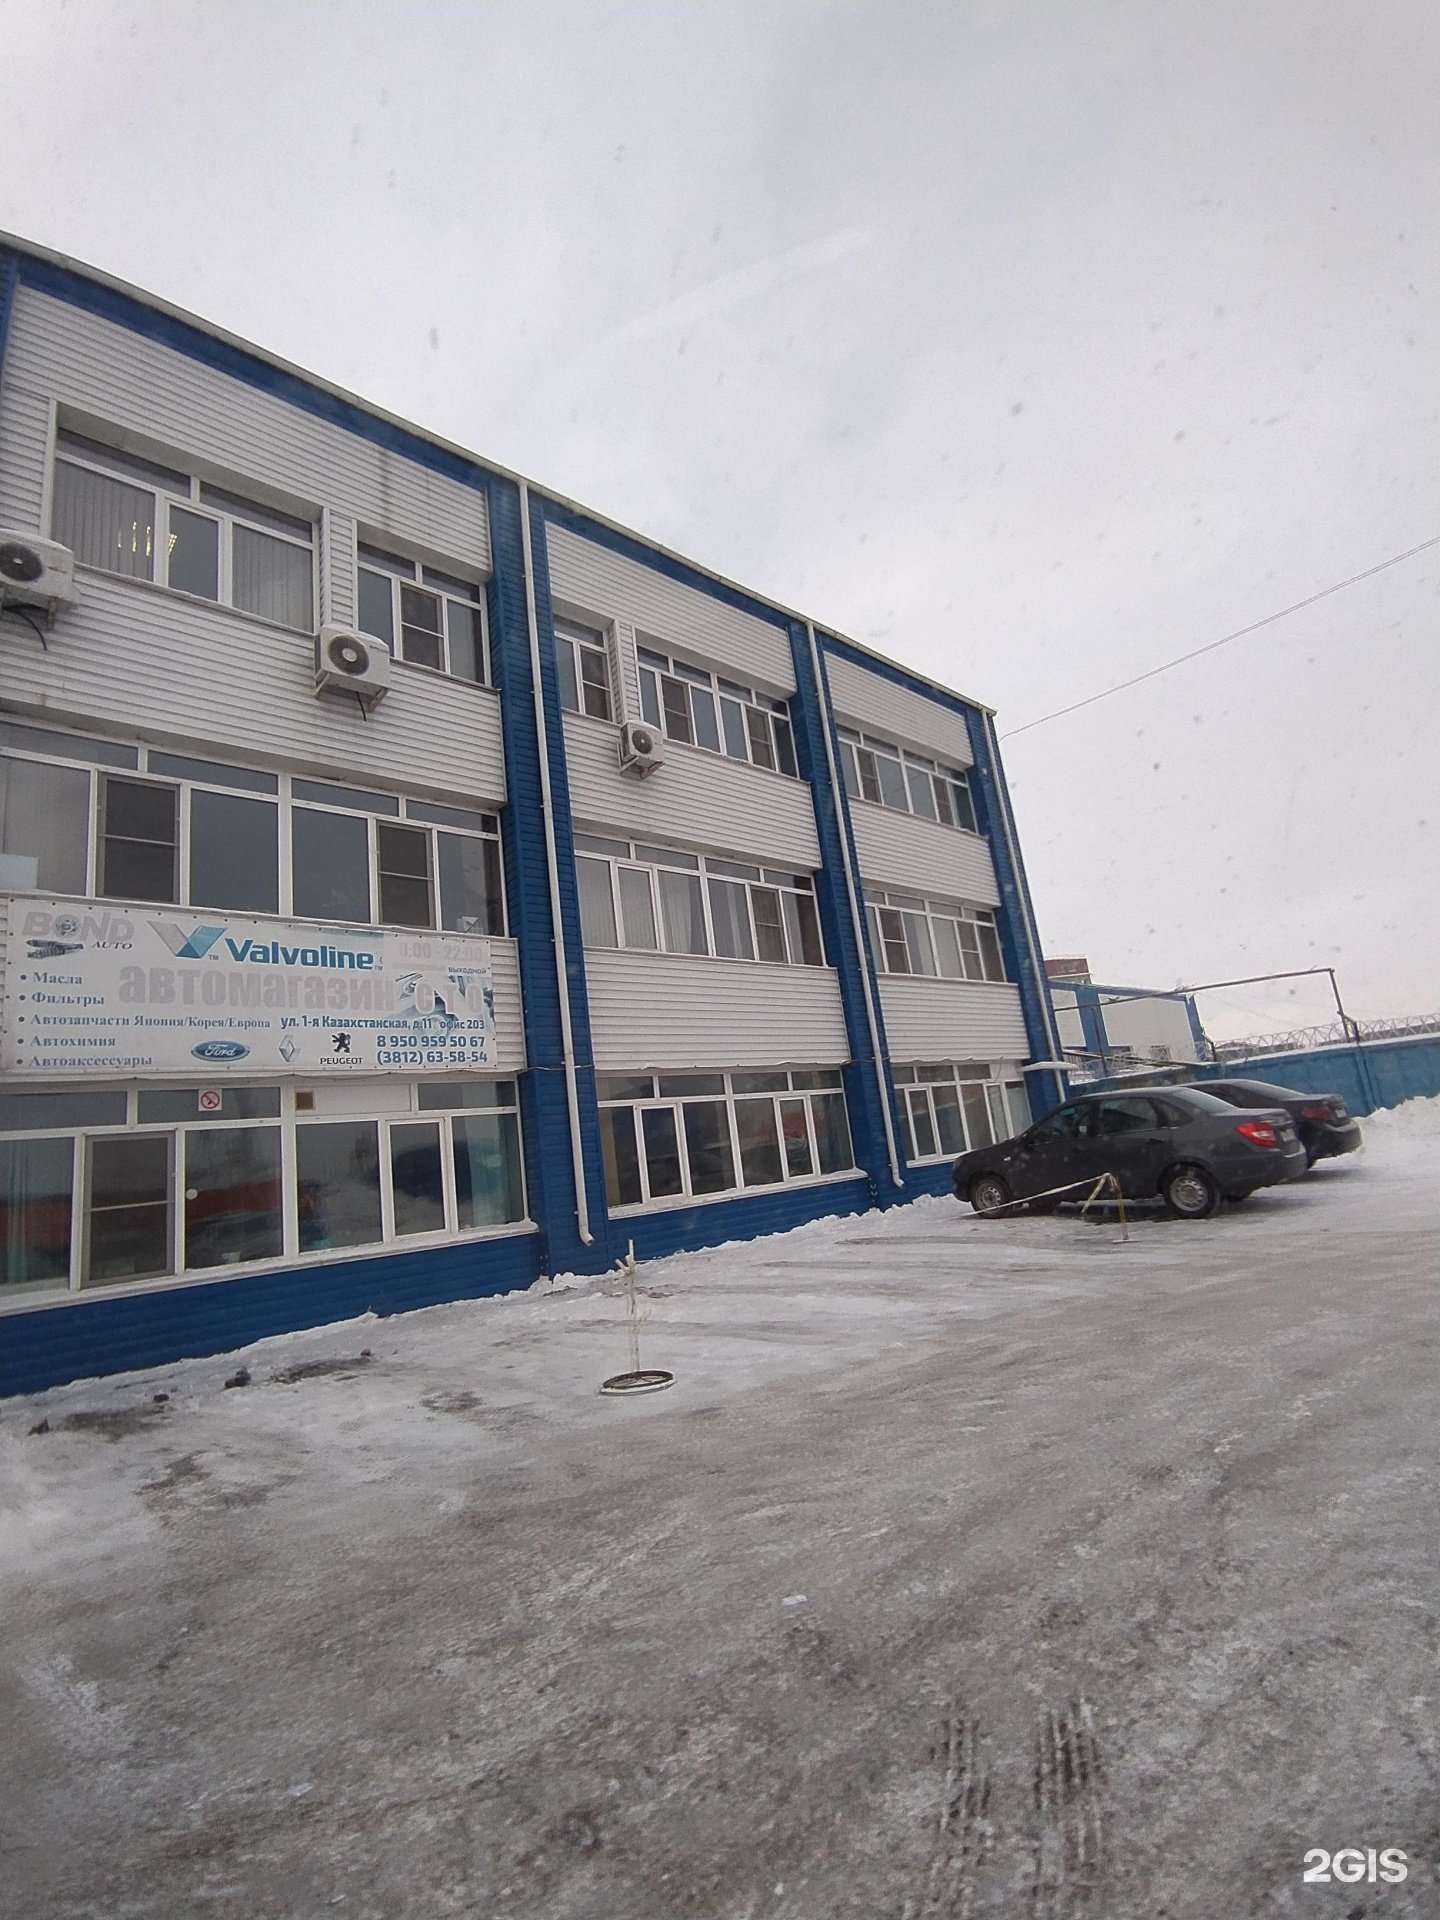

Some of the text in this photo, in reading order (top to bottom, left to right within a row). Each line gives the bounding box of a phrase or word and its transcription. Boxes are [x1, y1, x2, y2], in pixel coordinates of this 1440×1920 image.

[225, 938, 374, 970] Valvoline
[33, 972, 83, 985] Масла
[31, 992, 105, 1008] Фильтры
[30, 1014, 130, 1026] Автозапчасти
[281, 1017, 300, 1029] ул.
[302, 1015, 320, 1027] 1-я
[467, 1019, 485, 1029] 203
[30, 1036, 116, 1047] Автохимия
[377, 1035, 485, 1047] 8 950 959 50 67
[204, 1044, 236, 1056] Ford
[29, 1056, 152, 1068] Автоаксессуары
[320, 1057, 364, 1065] PEUGEOT
[377, 1050, 488, 1065] (3812) 63-58-54
